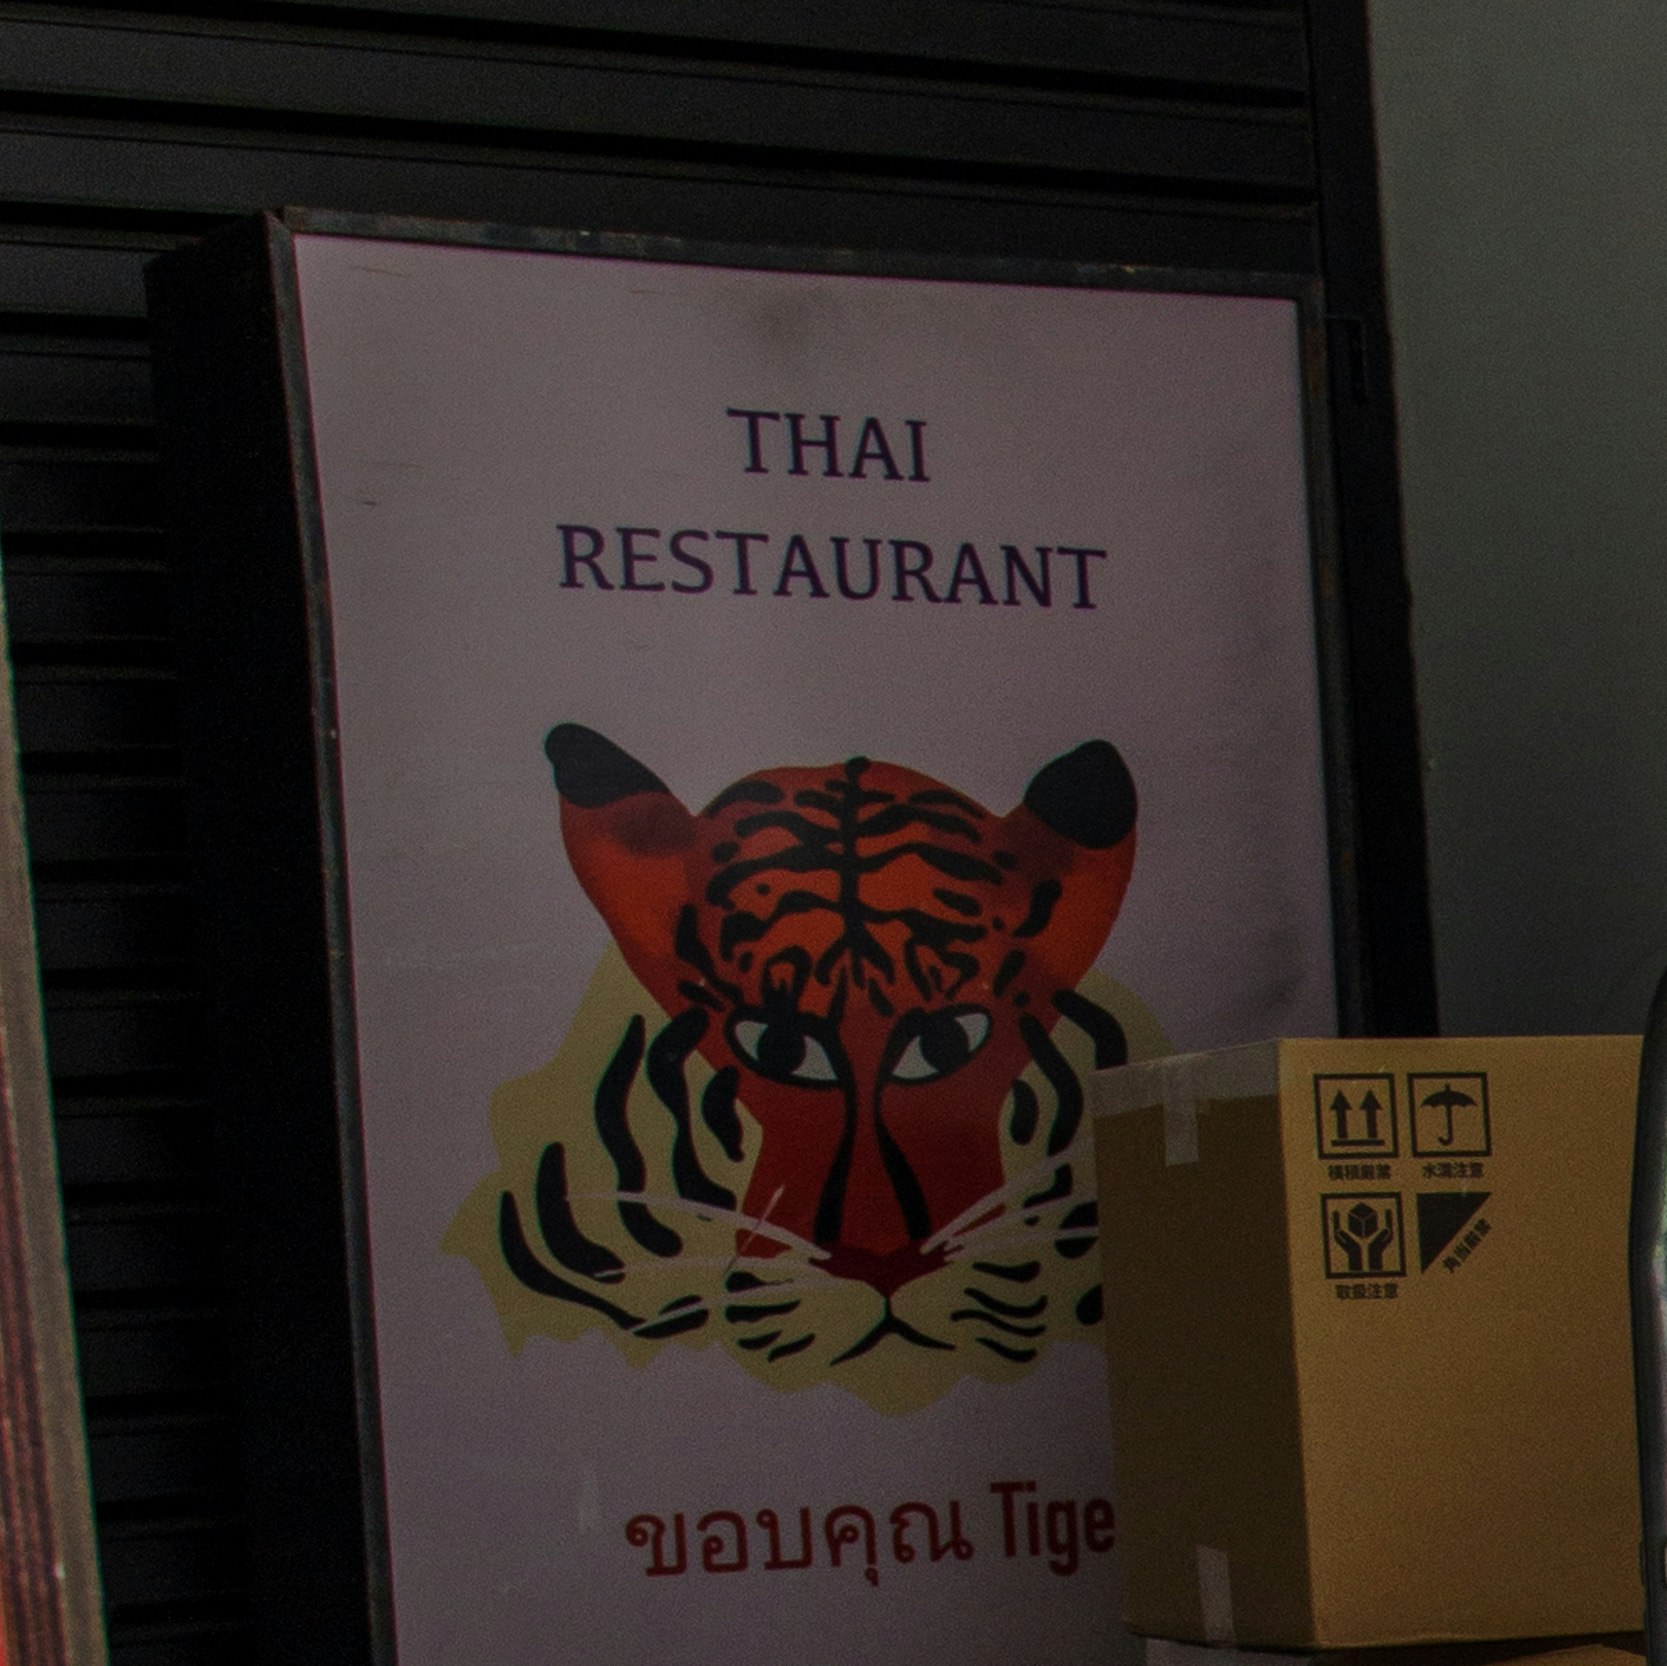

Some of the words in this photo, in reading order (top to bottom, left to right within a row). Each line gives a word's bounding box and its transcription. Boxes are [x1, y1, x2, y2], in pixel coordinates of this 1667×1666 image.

[728, 409, 932, 483] THAI
[556, 523, 1108, 609] RESTAURANT
[625, 1495, 971, 1588] ขอบคุณ
[991, 1481, 1115, 1575] Tige
